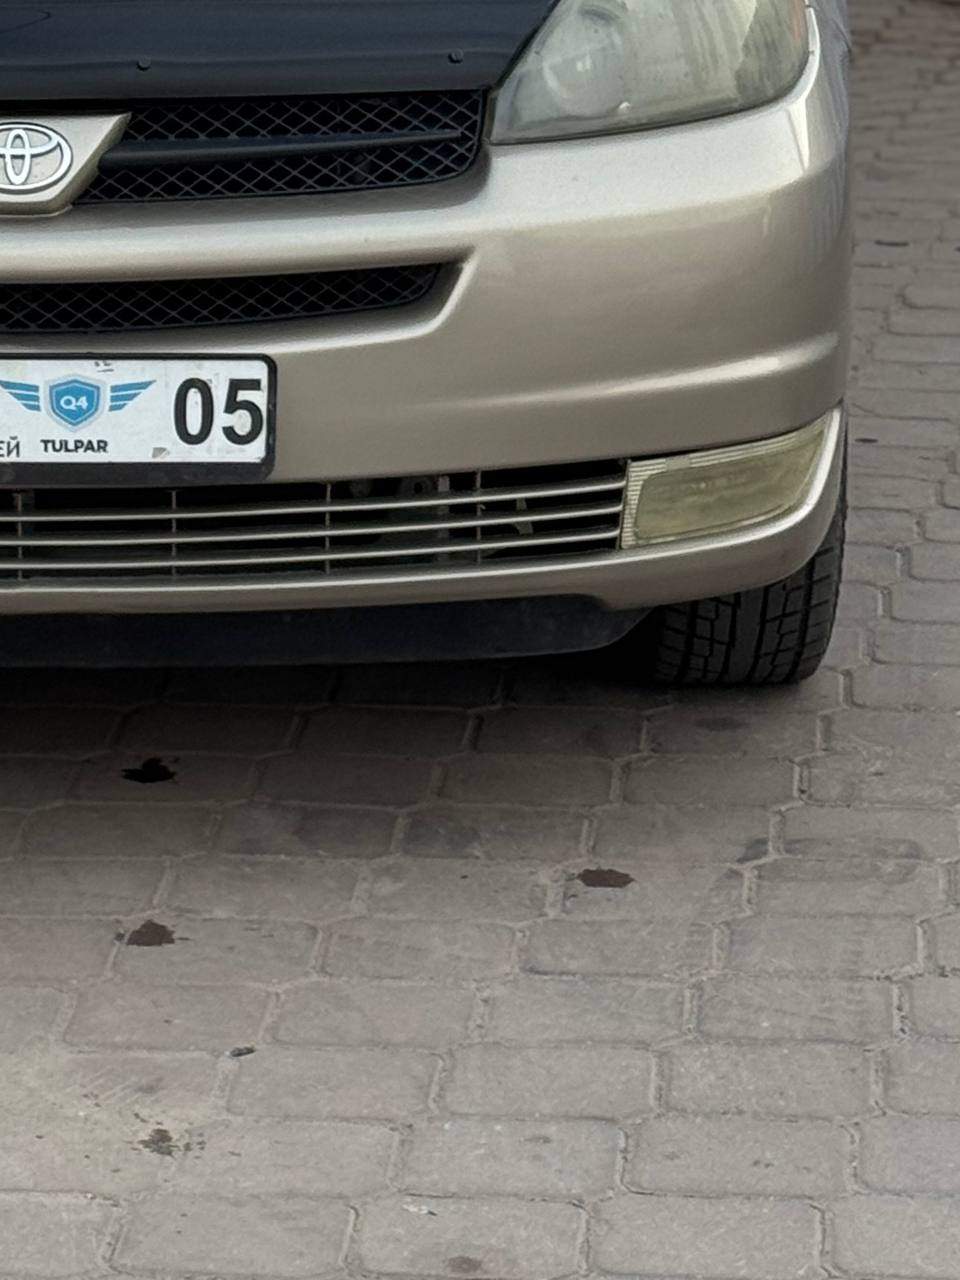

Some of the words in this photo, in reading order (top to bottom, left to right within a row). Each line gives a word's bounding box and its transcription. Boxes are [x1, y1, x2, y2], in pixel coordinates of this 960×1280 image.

[60, 395, 88, 410] Q4
[173, 377, 264, 446] 05
[40, 439, 108, 453] TULPAR
